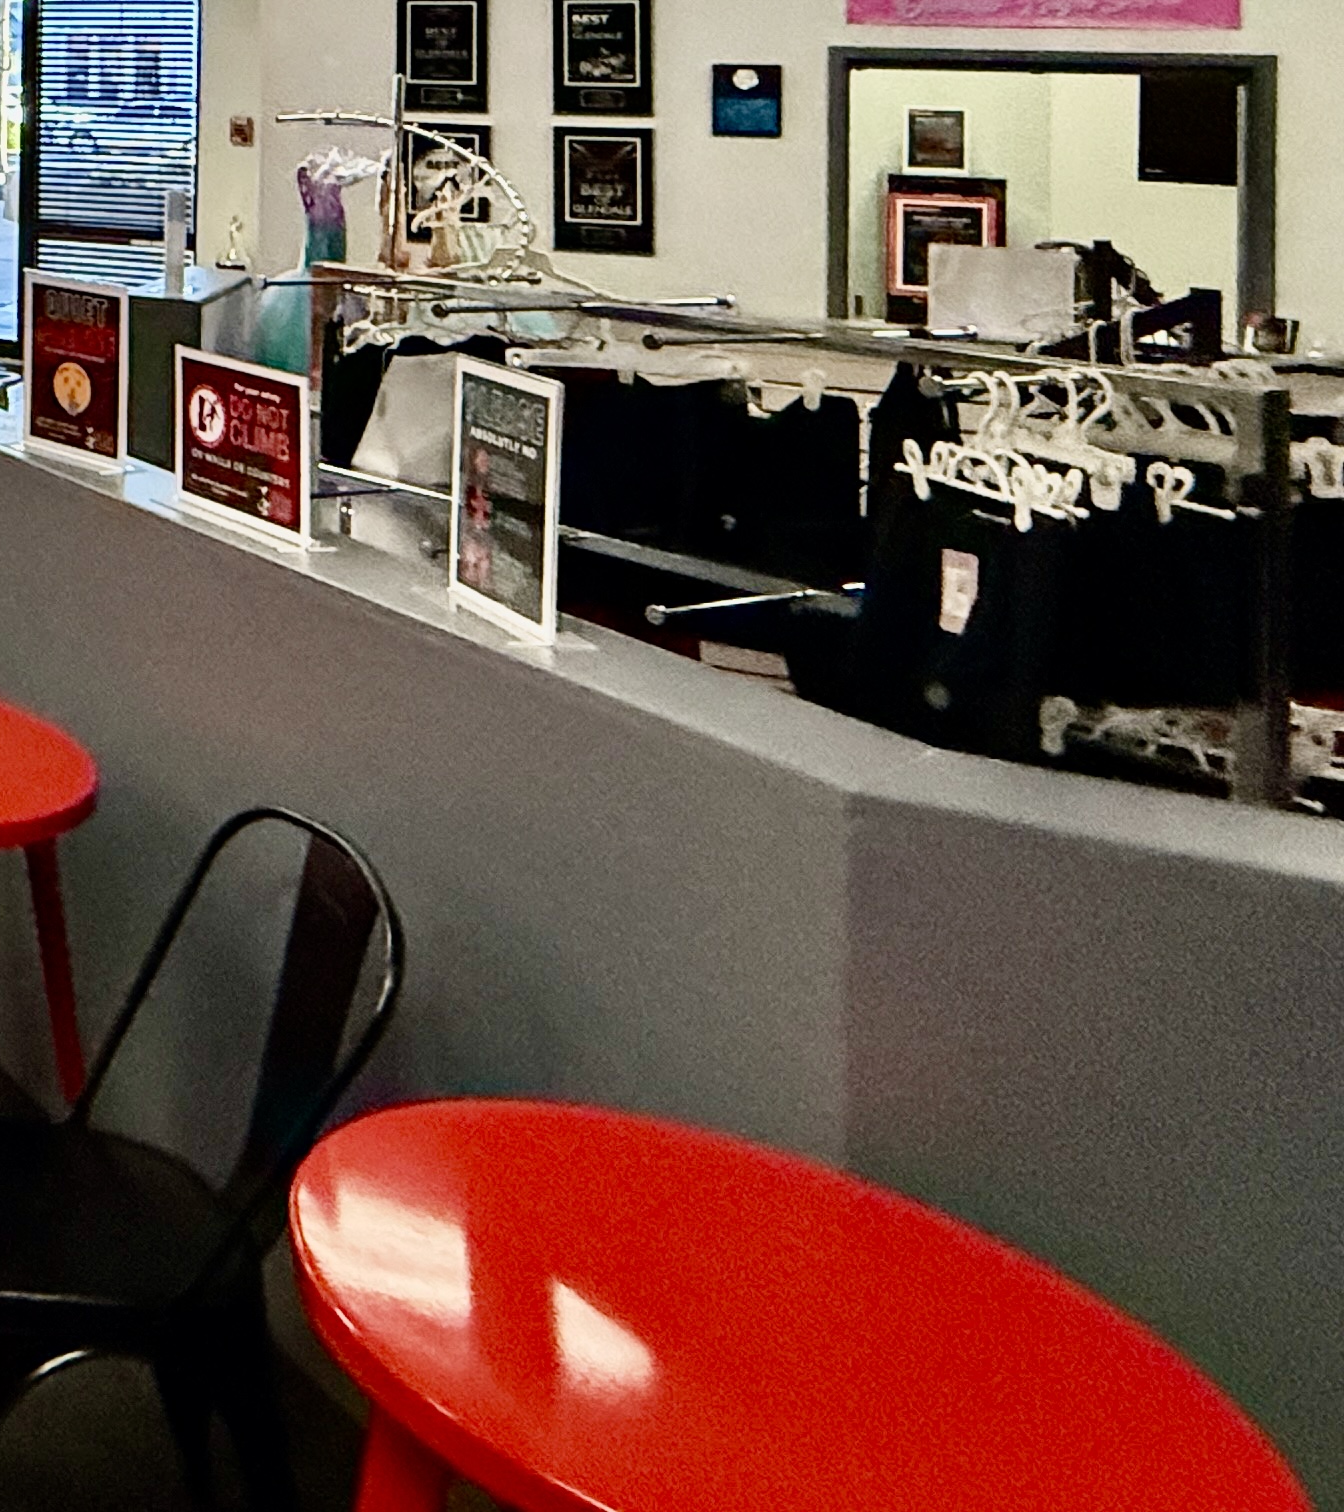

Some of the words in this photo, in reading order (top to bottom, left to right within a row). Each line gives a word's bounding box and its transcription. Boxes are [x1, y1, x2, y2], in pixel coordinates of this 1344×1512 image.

[229, 394, 253, 420] DO
[256, 403, 289, 431] NOT
[229, 419, 290, 462] CLIMB
